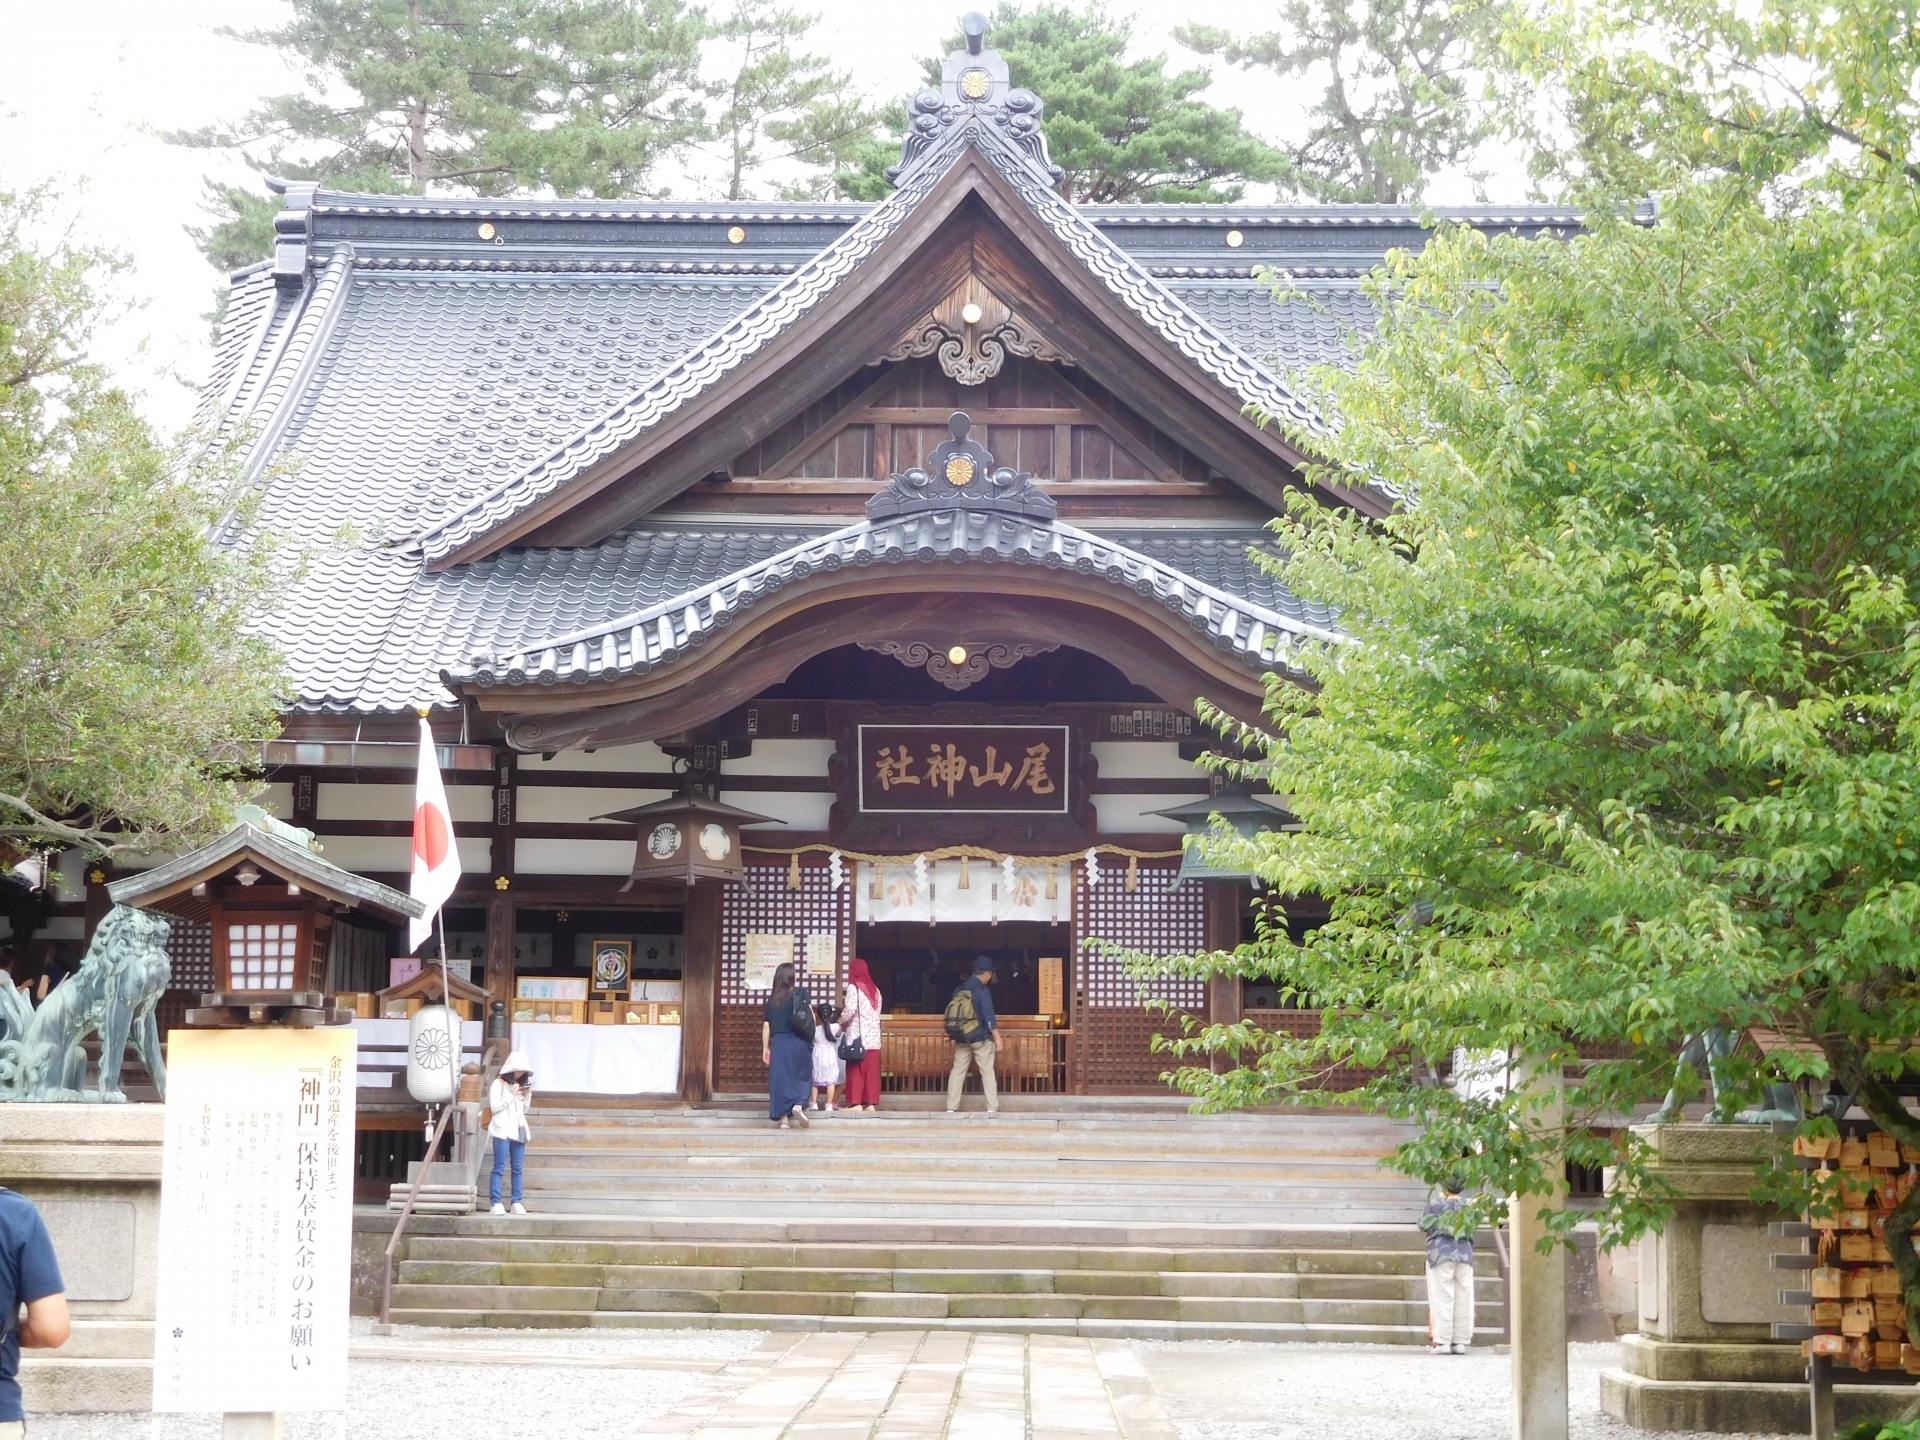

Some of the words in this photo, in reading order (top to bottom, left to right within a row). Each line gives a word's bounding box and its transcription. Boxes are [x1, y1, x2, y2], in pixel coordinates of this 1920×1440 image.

[874, 742, 1056, 798] 尾山神社
[289, 1066, 324, 1371] 『神門』保持奉賛金のお願い
